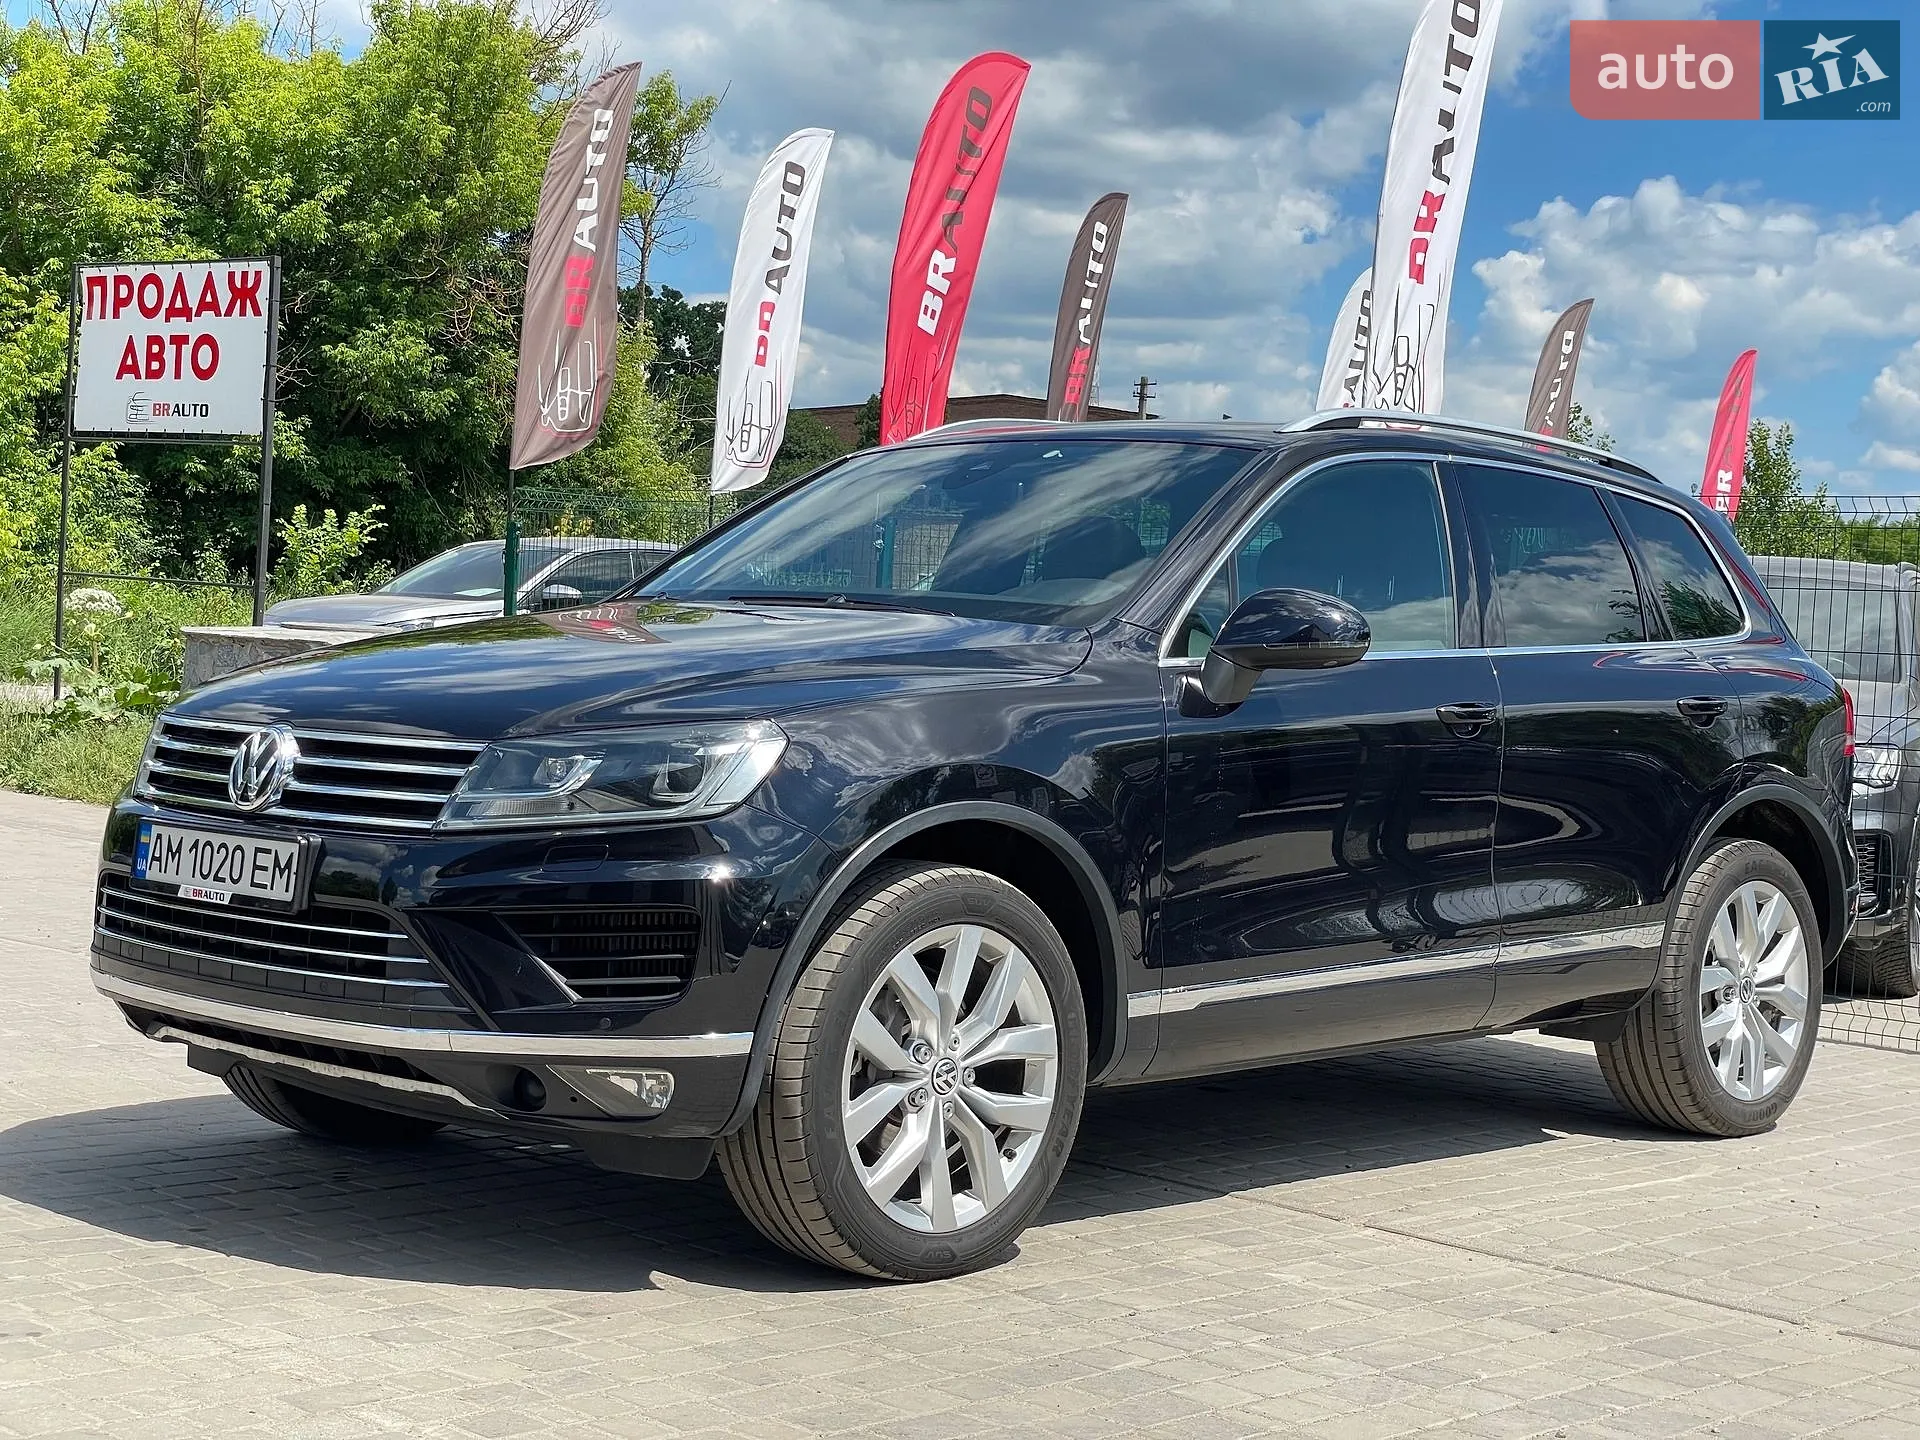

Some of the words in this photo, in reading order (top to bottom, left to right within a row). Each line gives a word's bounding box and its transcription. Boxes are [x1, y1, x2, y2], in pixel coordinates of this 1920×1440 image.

[564, 108, 614, 328] BRAUTO
[86, 270, 263, 323] ПРОДАЖ
[115, 333, 220, 381] АВТО
[152, 402, 210, 418] BRAUTO
[137, 858, 147, 871] UA
[148, 832, 184, 876] AM
[188, 838, 246, 885] 1020
[250, 846, 295, 893] EM
[191, 888, 225, 902] BRAUTO
